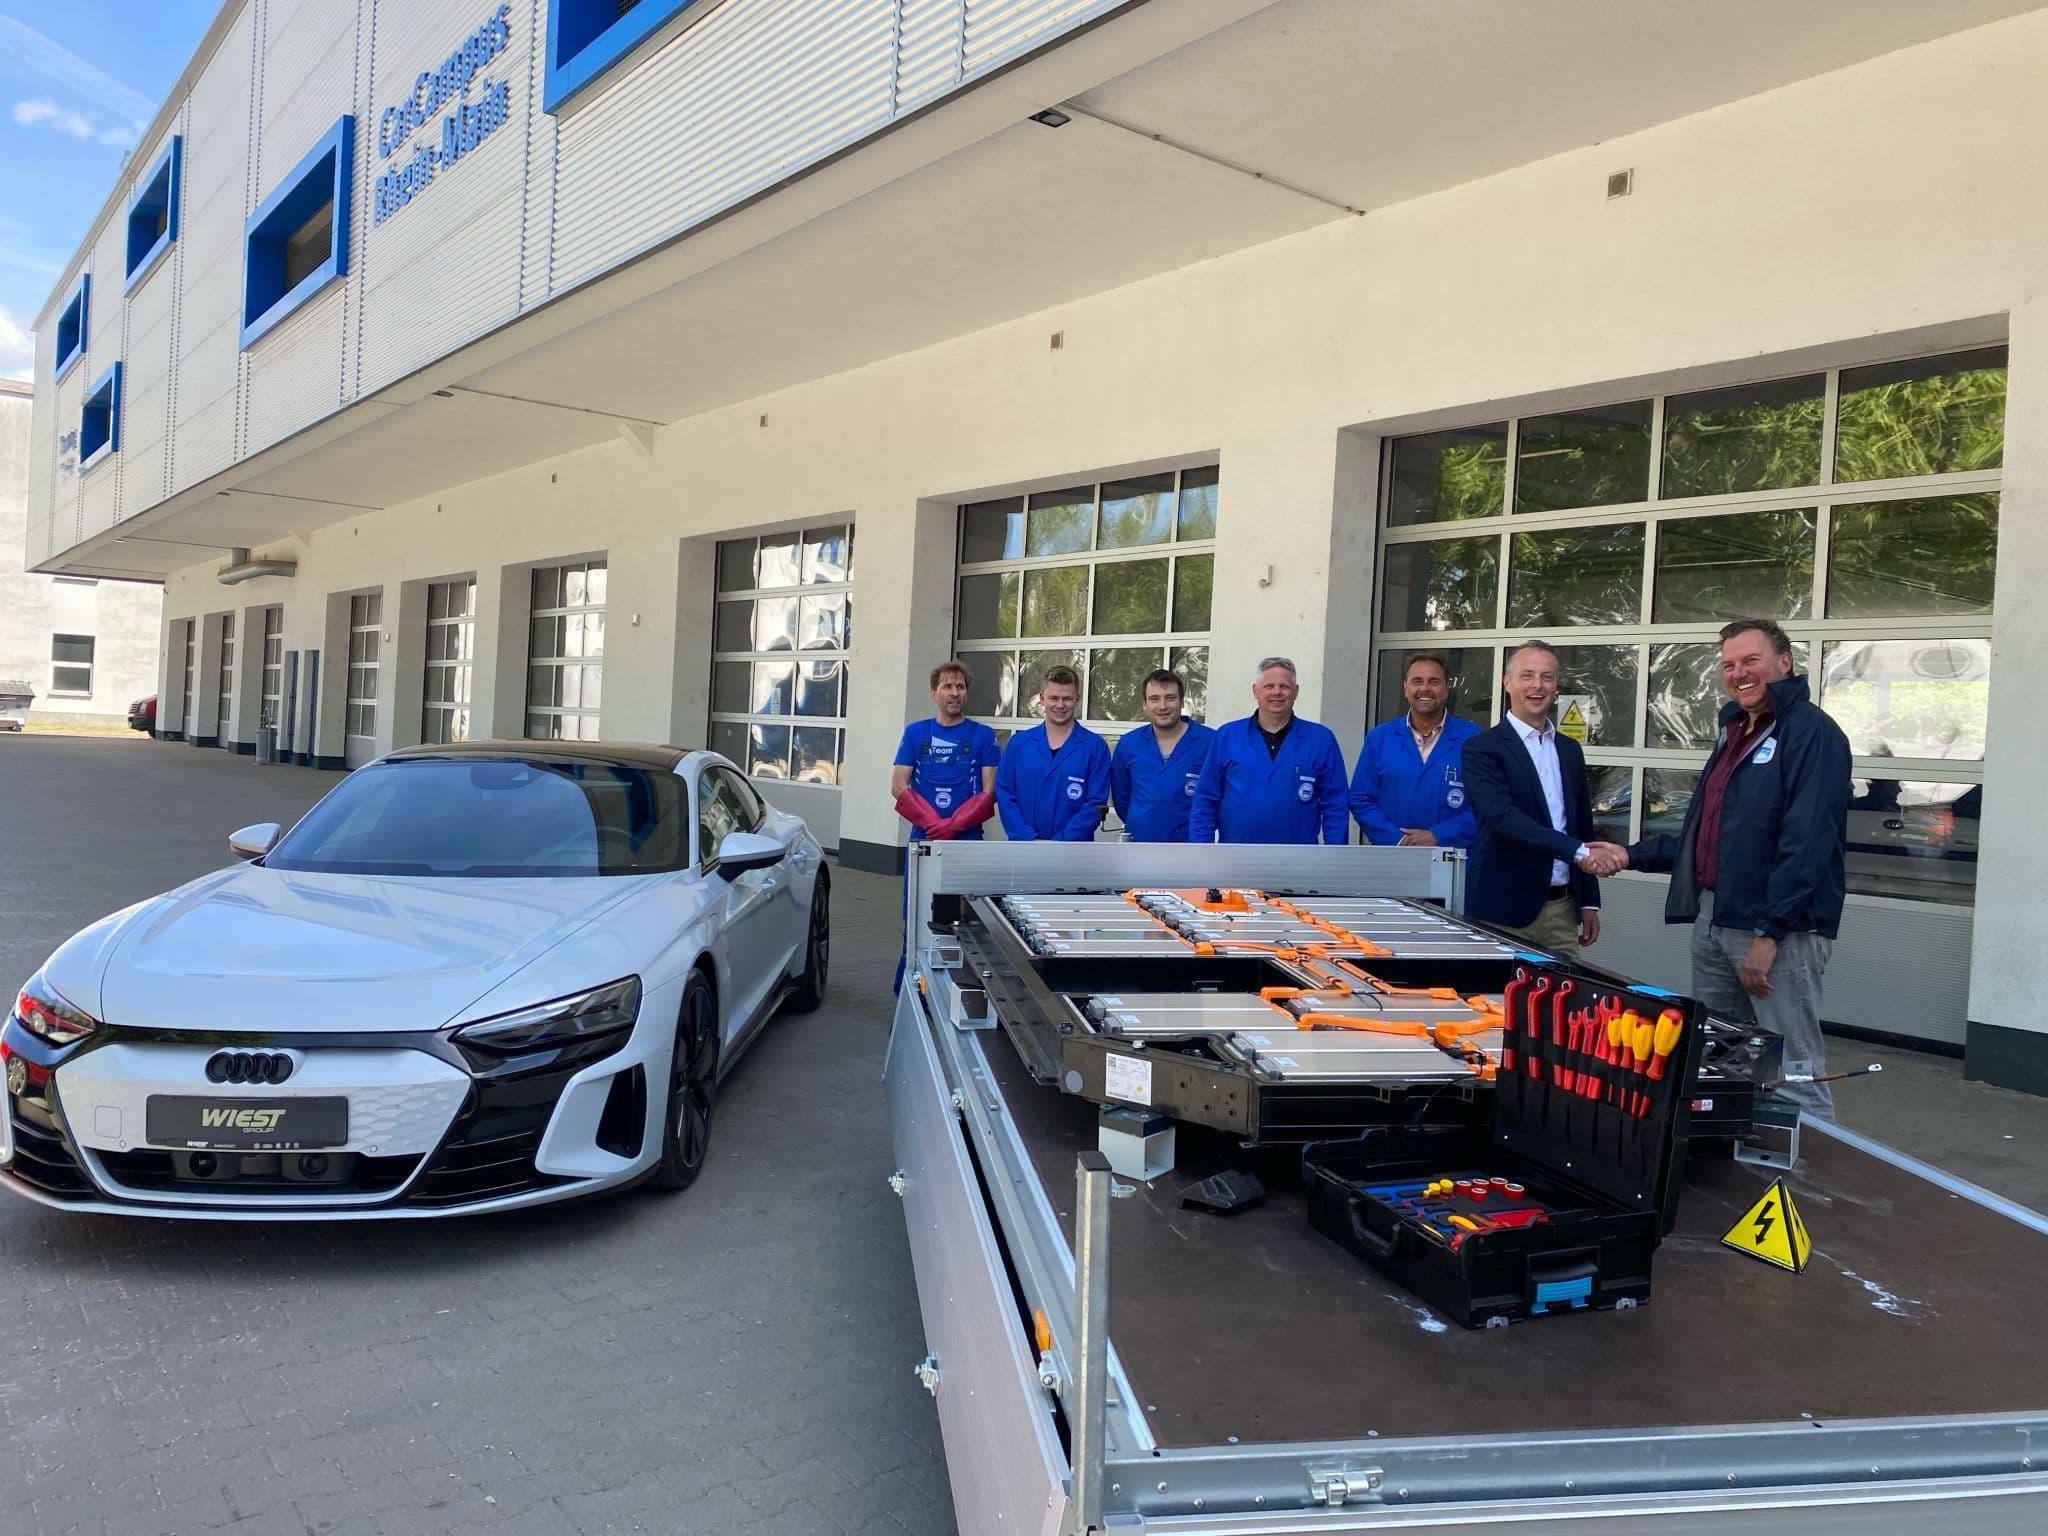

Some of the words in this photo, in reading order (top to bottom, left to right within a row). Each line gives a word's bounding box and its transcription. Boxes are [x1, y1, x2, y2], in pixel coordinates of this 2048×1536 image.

[374, 76, 508, 228] Rhein-Main
[379, 4, 510, 158] CarCampus
[202, 1109, 286, 1128] WIEST
